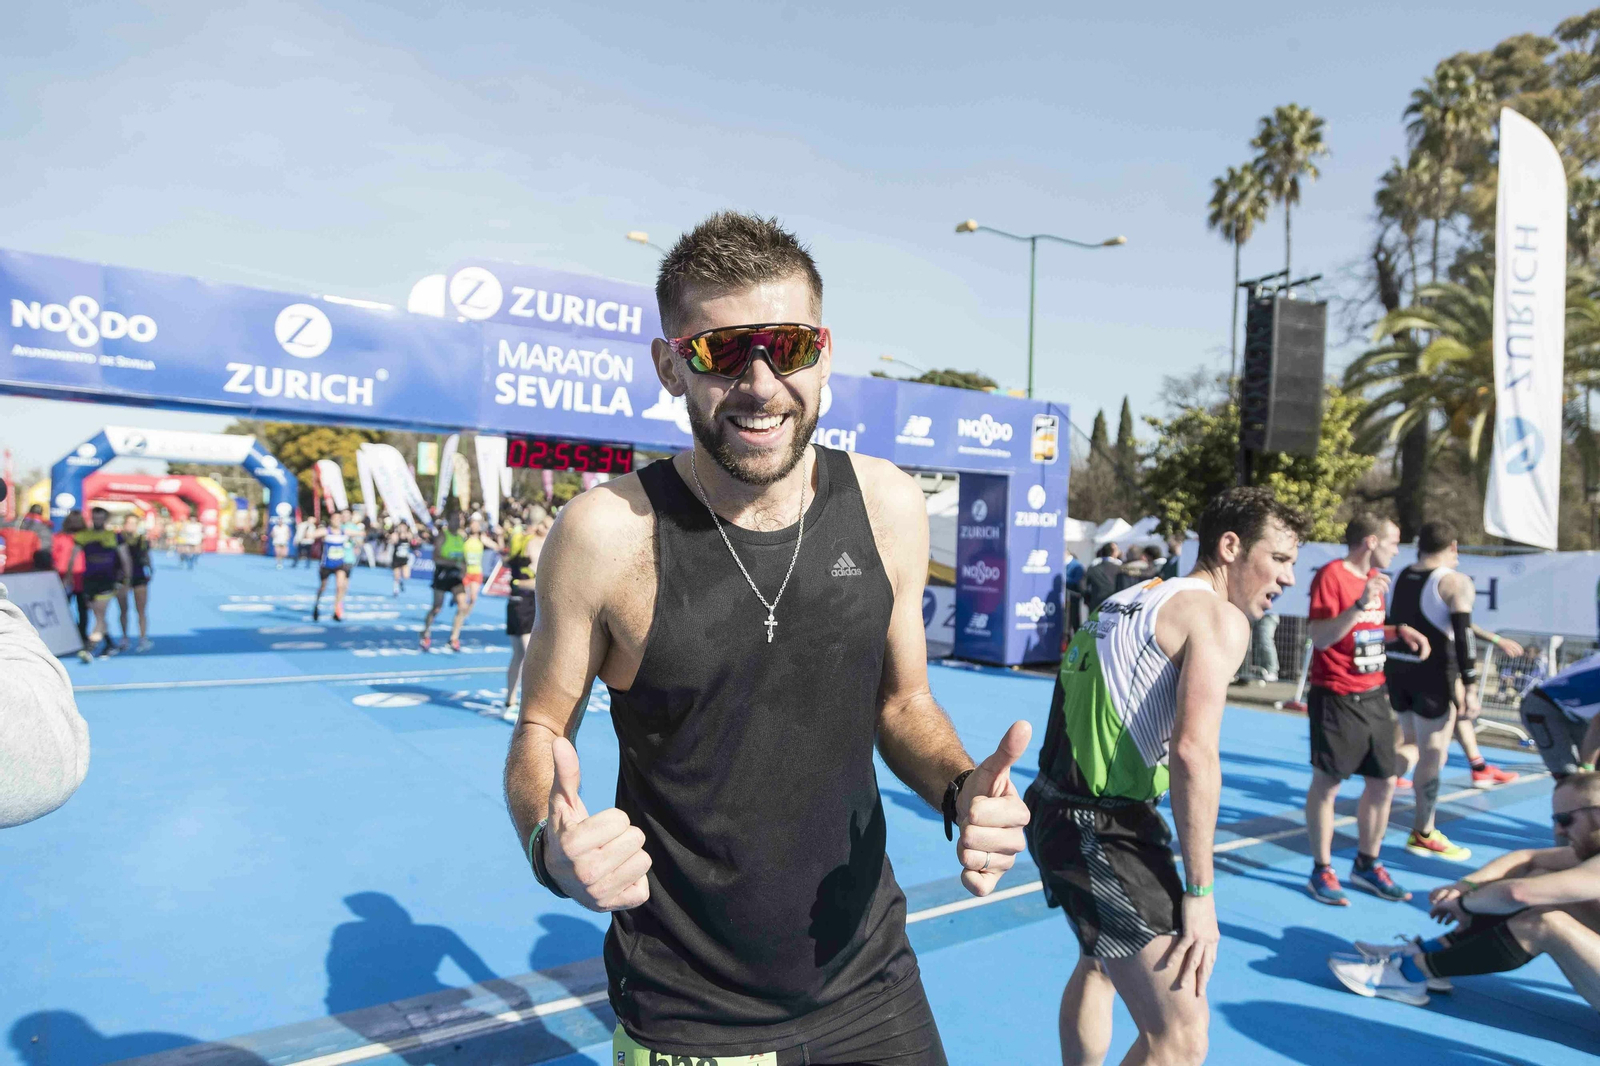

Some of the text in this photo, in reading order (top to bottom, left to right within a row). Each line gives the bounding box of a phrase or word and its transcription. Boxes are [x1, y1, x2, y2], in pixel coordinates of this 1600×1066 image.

[509, 286, 642, 334] ZURICH
[498, 339, 633, 383] MARATÓN
[223, 362, 374, 406] ZURICH
[495, 372, 634, 418] SEVILLA
[507, 438, 632, 474] 02:55:34
[810, 427, 857, 452] ICH
[959, 525, 1000, 540] ZURICH
[1015, 511, 1058, 528] ZURICH
[831, 567, 862, 577] adidas
